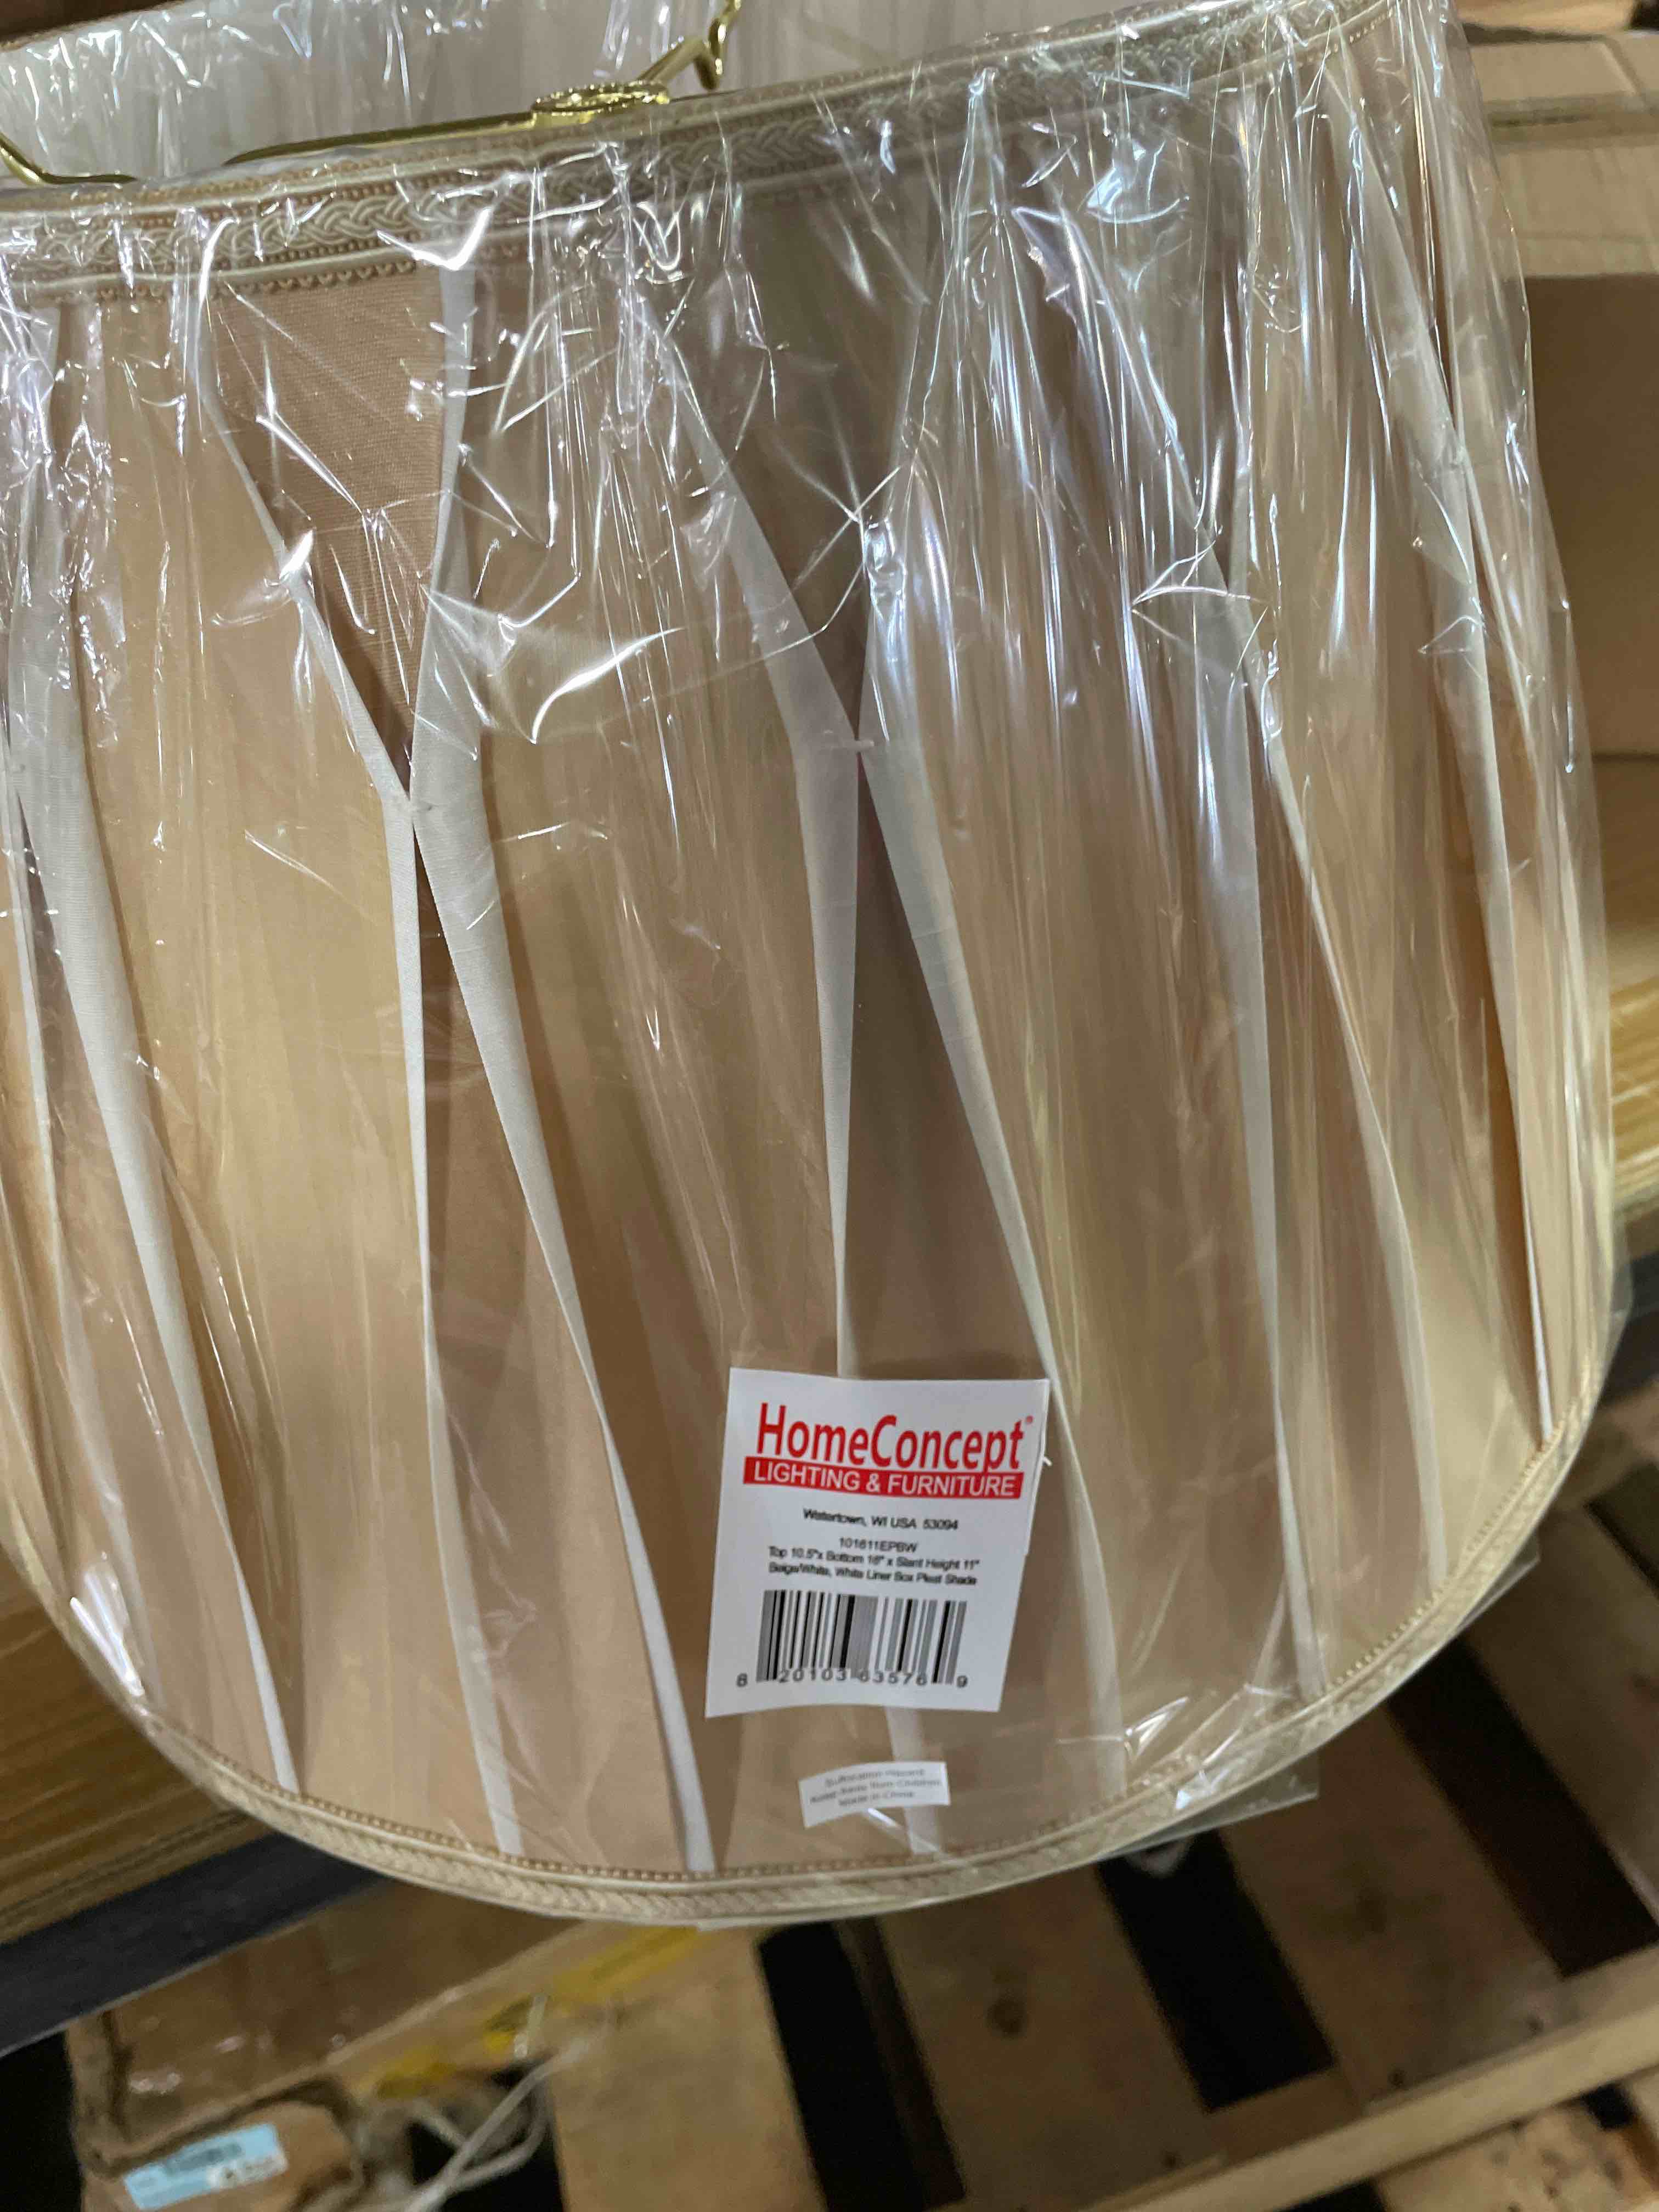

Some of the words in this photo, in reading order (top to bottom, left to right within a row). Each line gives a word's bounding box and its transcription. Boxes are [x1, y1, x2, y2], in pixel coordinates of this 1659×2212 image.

[757, 1403, 1023, 1475] HomeConcept
[754, 1460, 860, 1491] LIGHTING
[865, 1474, 879, 1492] &
[887, 1473, 1015, 1497] FURNITURE
[890, 1517, 916, 1528] USA
[923, 1519, 958, 1530] 53094
[768, 1545, 787, 1559] Top
[826, 1551, 864, 1564] Bottom
[926, 1558, 960, 1571] Height
[866, 1568, 891, 1581] Liner
